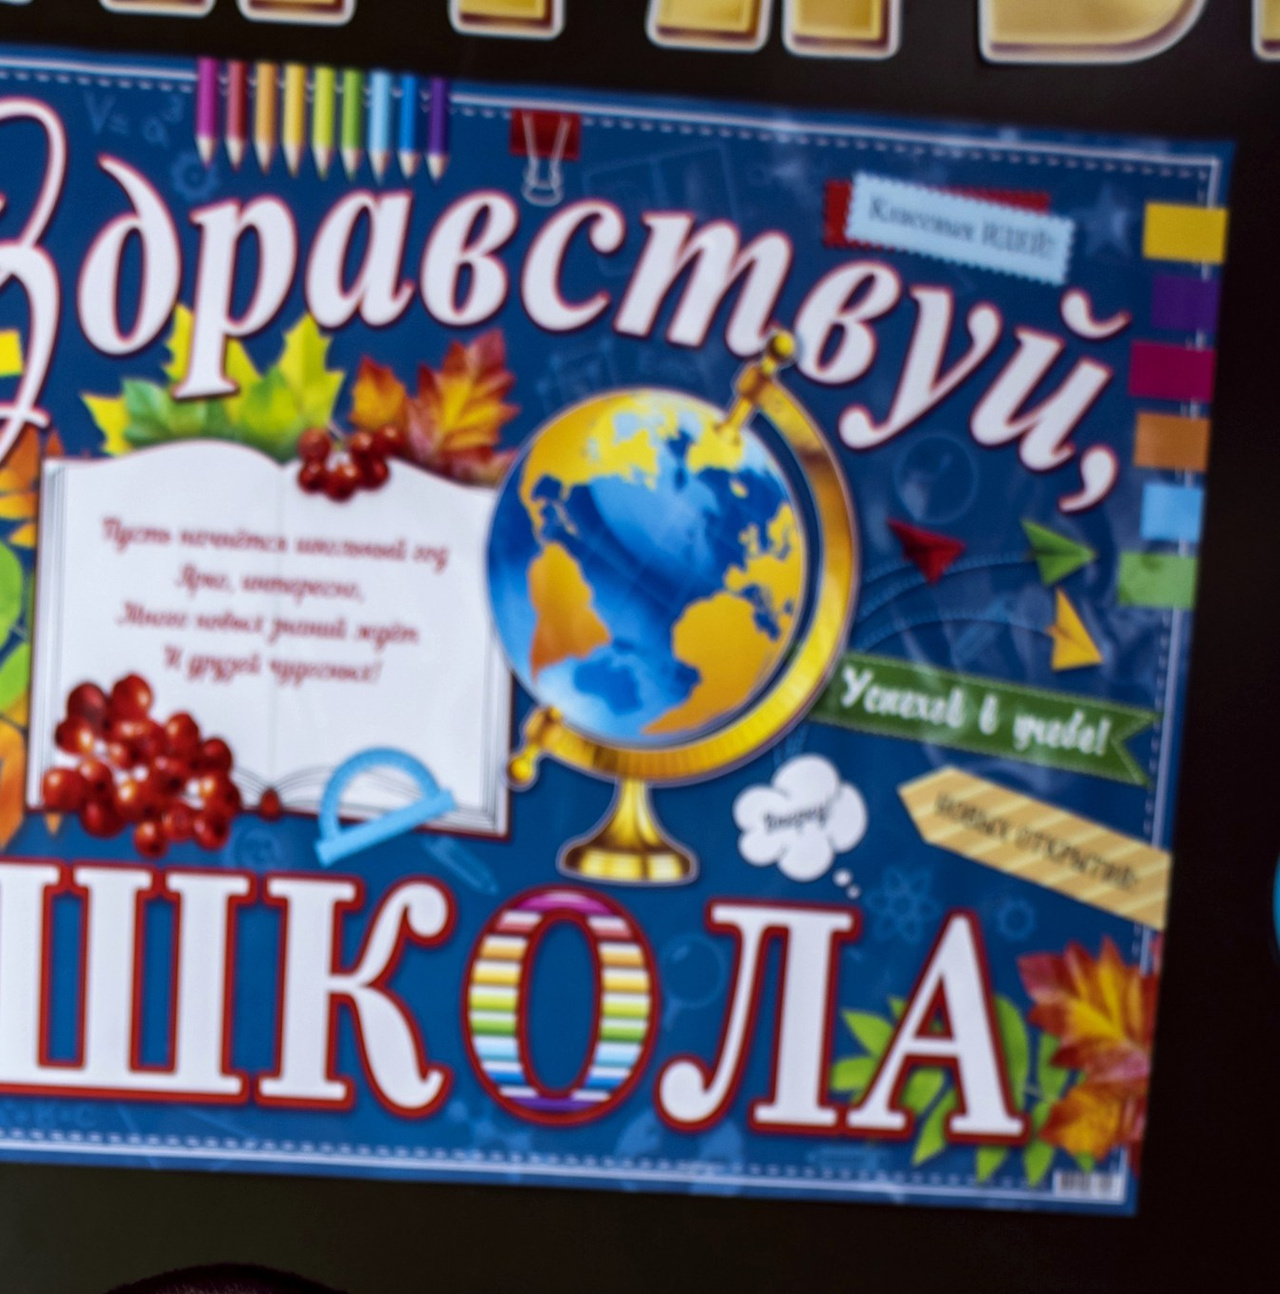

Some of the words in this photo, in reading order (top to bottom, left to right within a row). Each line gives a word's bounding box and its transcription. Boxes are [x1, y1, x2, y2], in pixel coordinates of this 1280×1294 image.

[102, 515, 171, 553] Пусть
[841, 664, 964, 729] Успехов
[979, 694, 1000, 735] в
